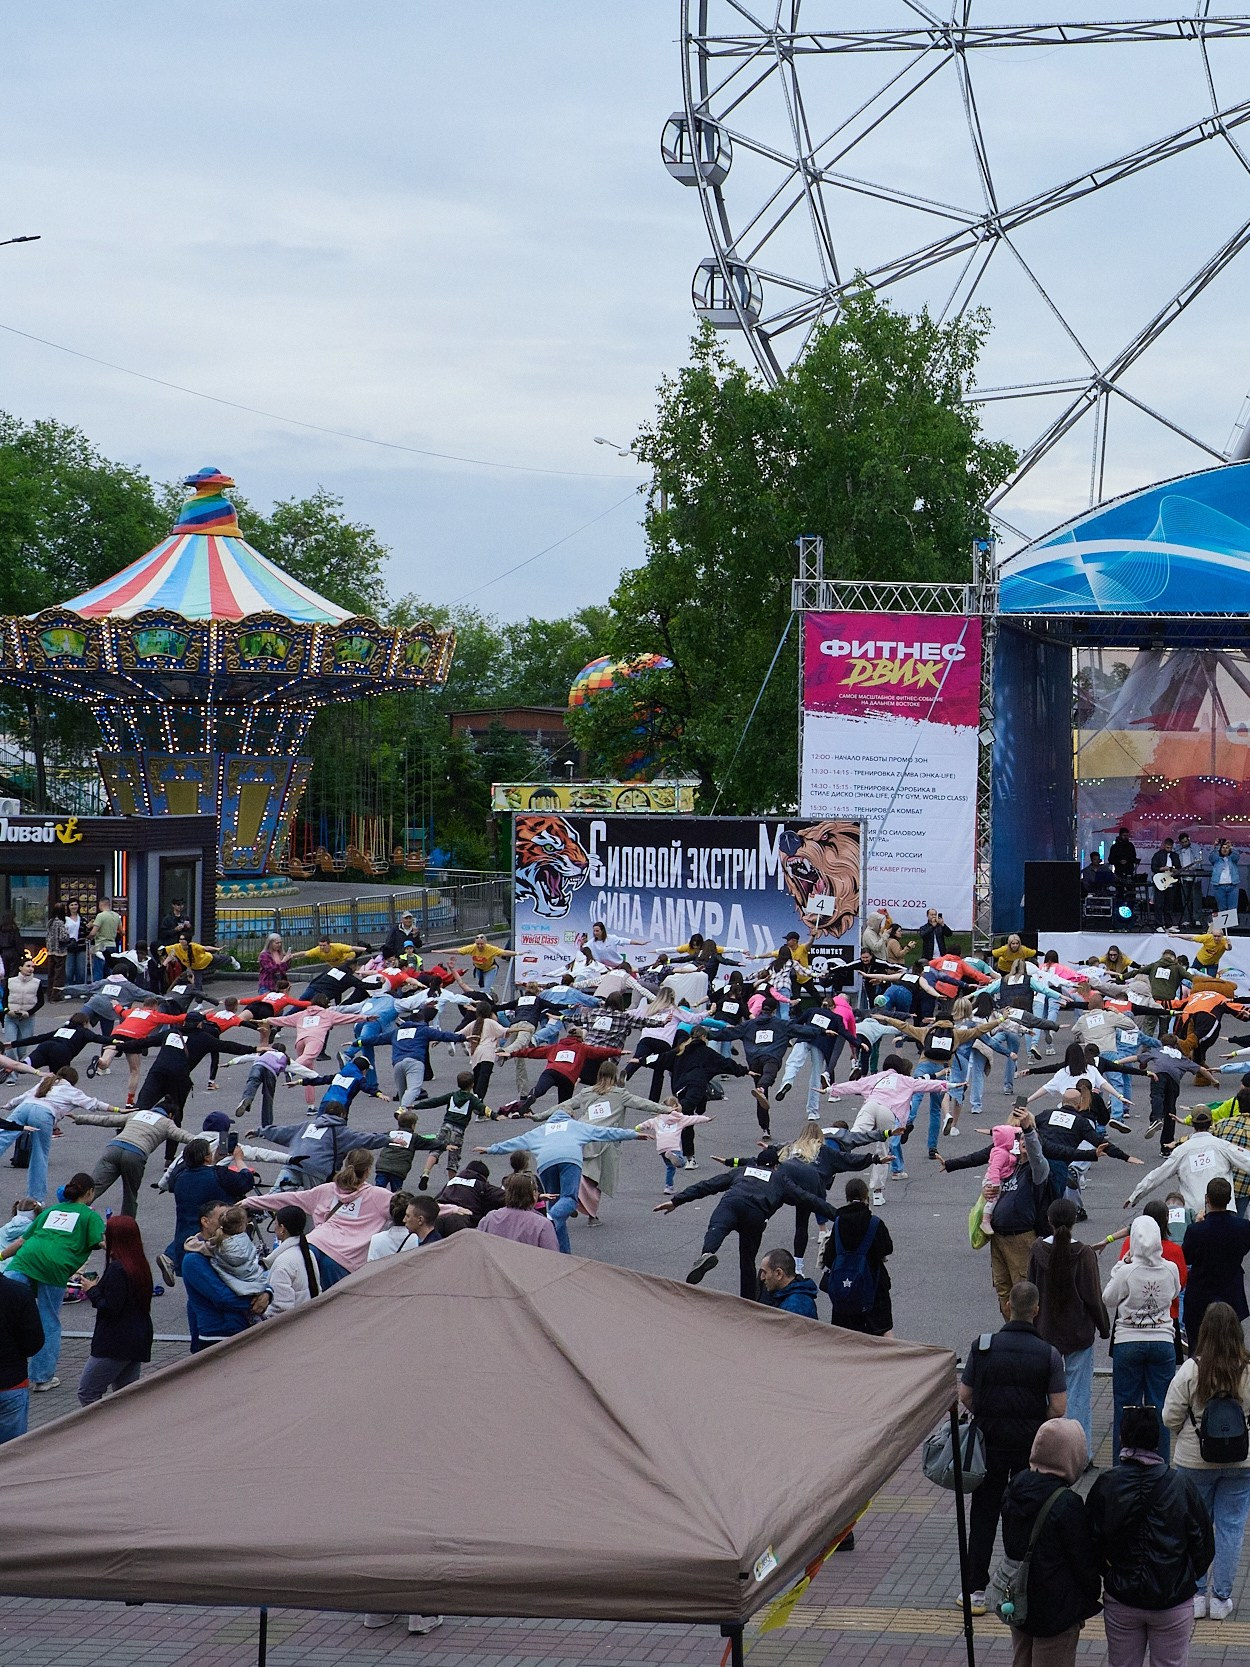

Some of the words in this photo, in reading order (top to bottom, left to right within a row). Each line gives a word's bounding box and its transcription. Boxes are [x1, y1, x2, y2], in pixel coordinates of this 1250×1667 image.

[820, 640, 966, 661] ФИТНЕС
[836, 658, 946, 690] ДВИЖ
[816, 900, 824, 910] 4
[589, 891, 644, 936] «СИЛА
[1221, 914, 1229, 925] 7
[522, 935, 540, 944] World
[541, 935, 558, 944] Class
[1193, 1157, 1211, 1167] 126
[53, 1217, 67, 1225] 77
